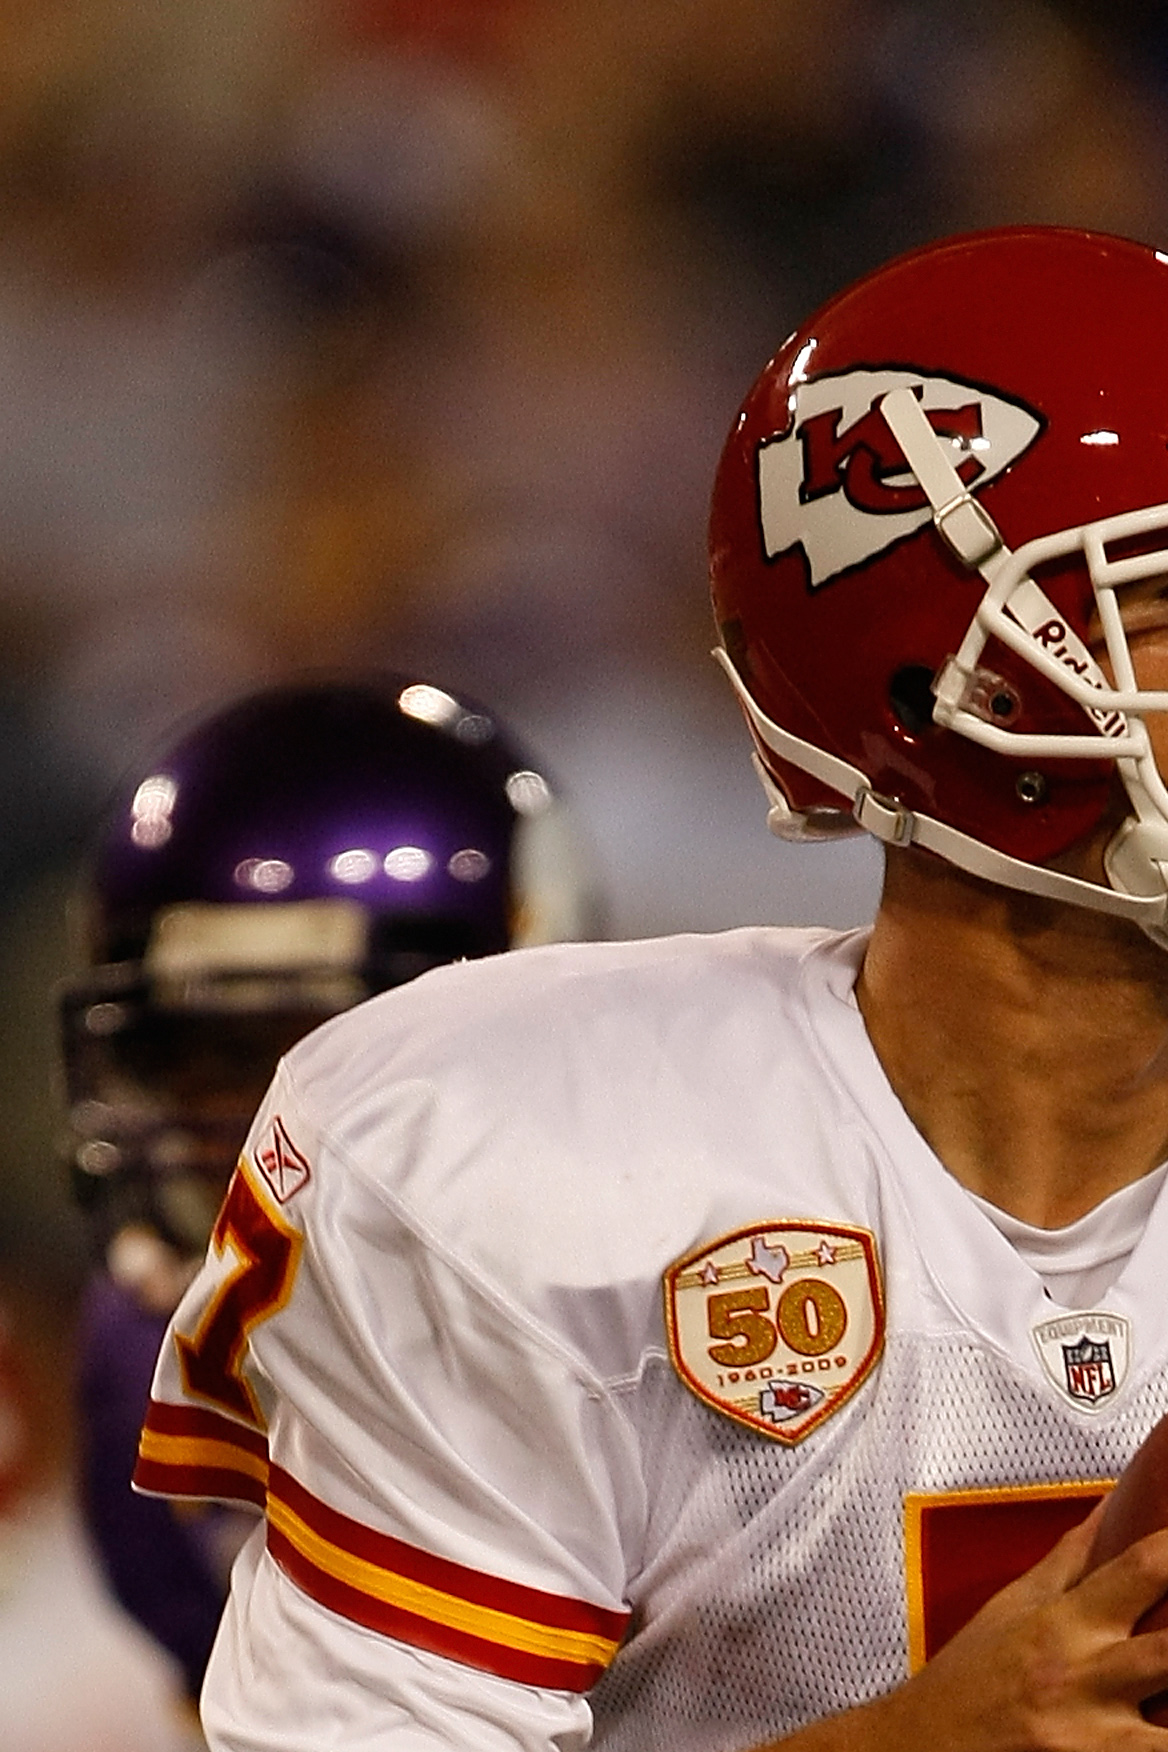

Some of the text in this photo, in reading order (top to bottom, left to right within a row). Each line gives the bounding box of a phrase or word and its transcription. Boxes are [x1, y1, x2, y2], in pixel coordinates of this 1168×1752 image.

[797, 384, 986, 515] KC
[174, 1153, 303, 1431] 7
[707, 1277, 848, 1367] 50
[1038, 1317, 1124, 1344] EQUIPMENT
[717, 1355, 848, 1388] 1960-2009
[1070, 1363, 1111, 1396] NFL
